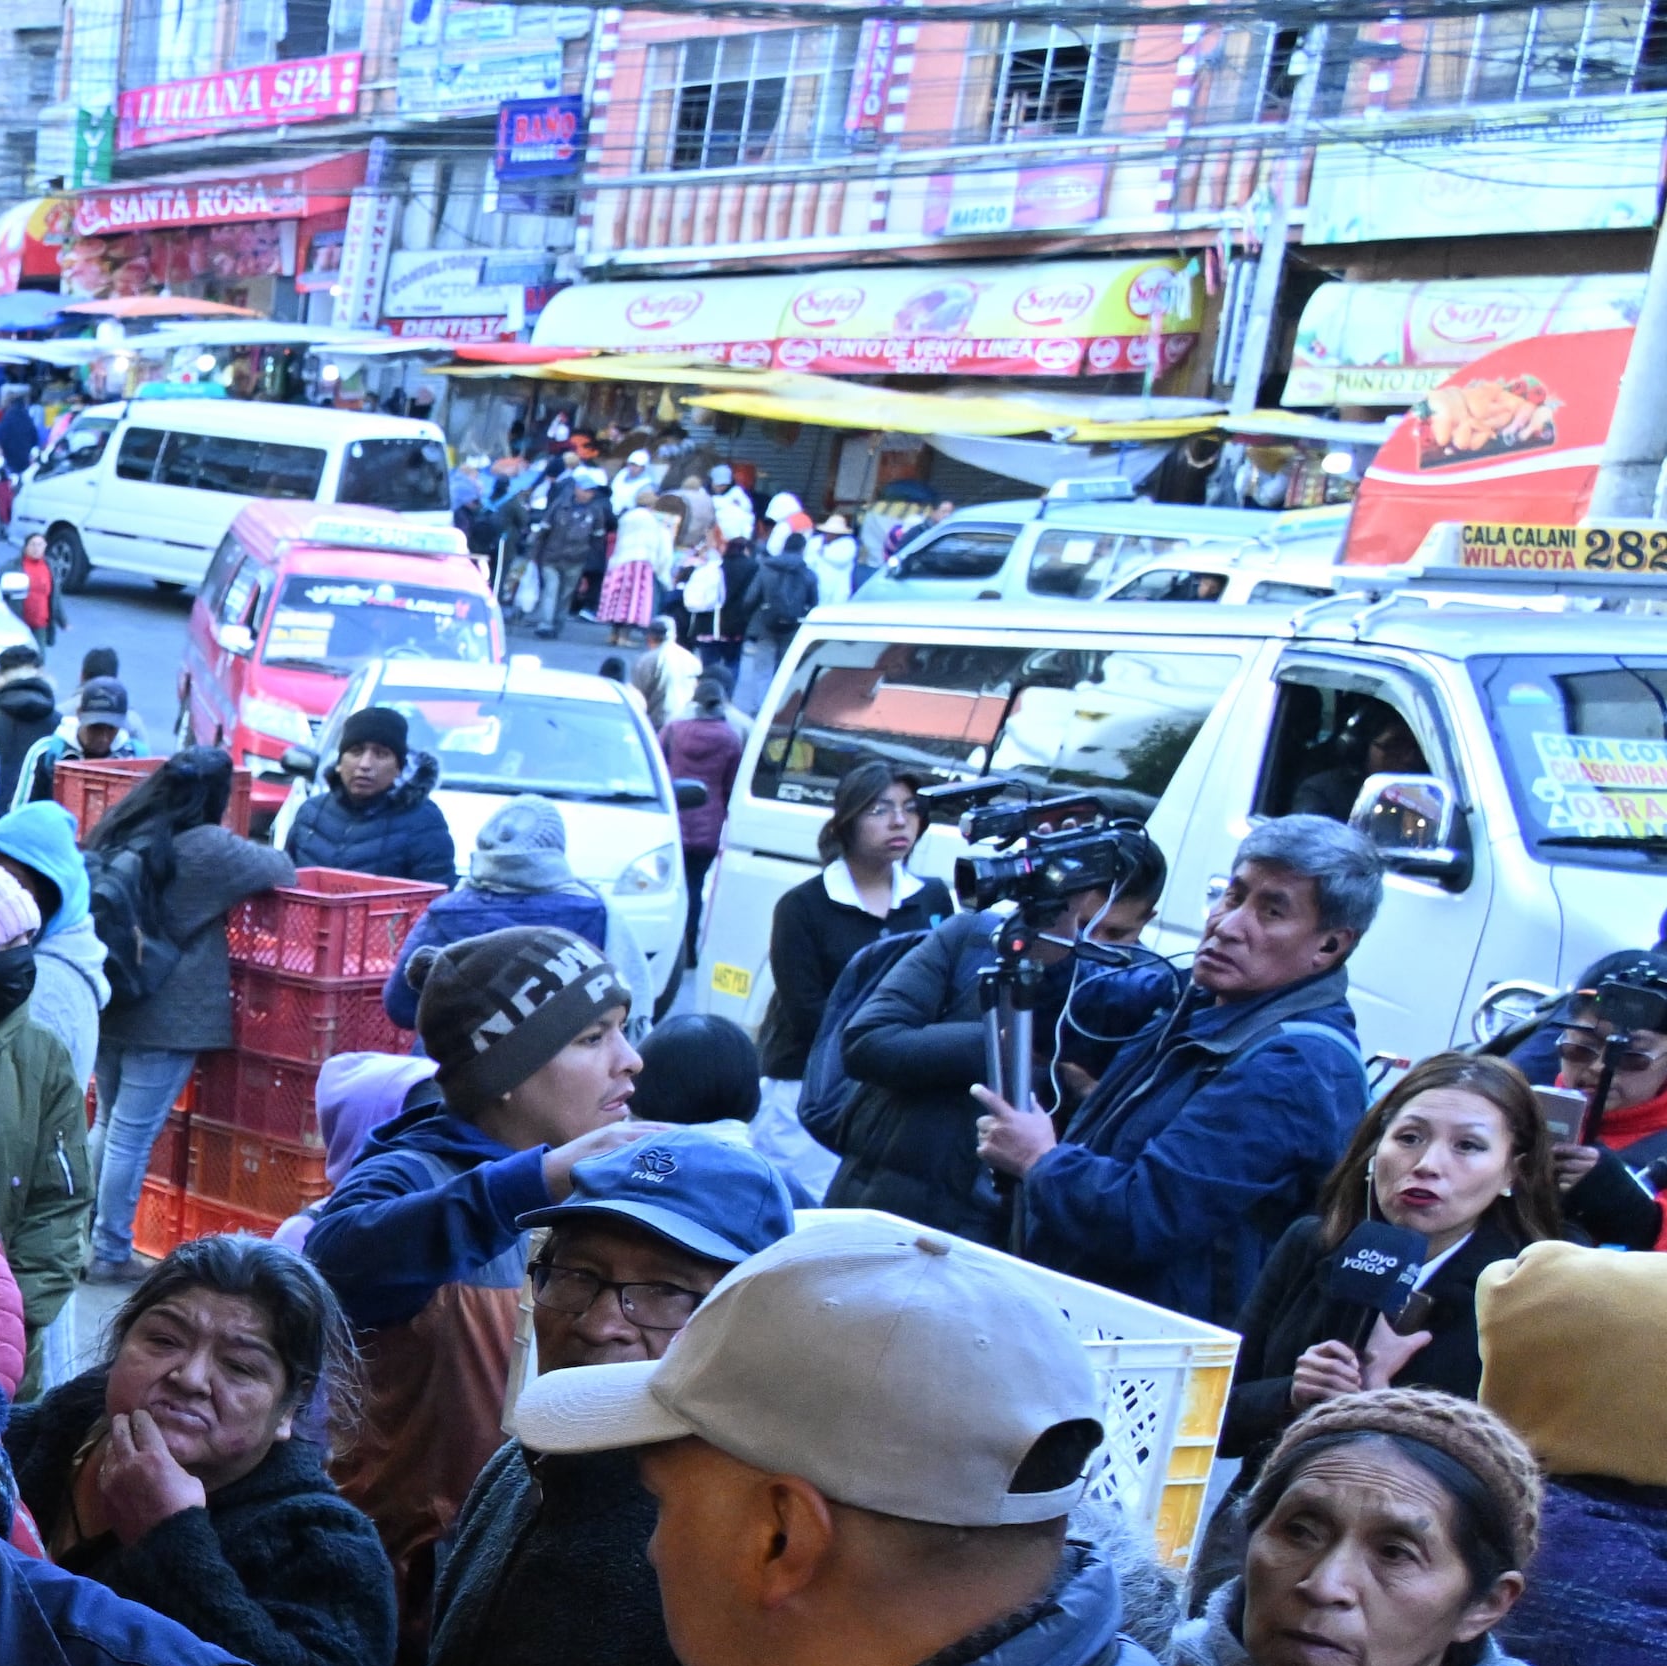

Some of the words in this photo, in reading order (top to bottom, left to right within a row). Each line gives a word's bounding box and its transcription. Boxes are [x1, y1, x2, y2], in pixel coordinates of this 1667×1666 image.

[270, 64, 333, 108] SPA
[515, 106, 576, 142] BAÑO
[110, 189, 190, 225] SANTA
[196, 182, 269, 217] ROSA
[359, 193, 390, 321] DENTISTA
[819, 338, 880, 357] PUNTO
[883, 338, 909, 358] DE
[913, 338, 974, 357] VENTA
[1336, 372, 1403, 391] PUNTO
[1411, 371, 1437, 391] DE
[1462, 525, 1507, 545] CALA
[1513, 527, 1576, 548] CALANI
[1463, 547, 1576, 569] WILACOTA
[1540, 736, 1616, 760] COTA
